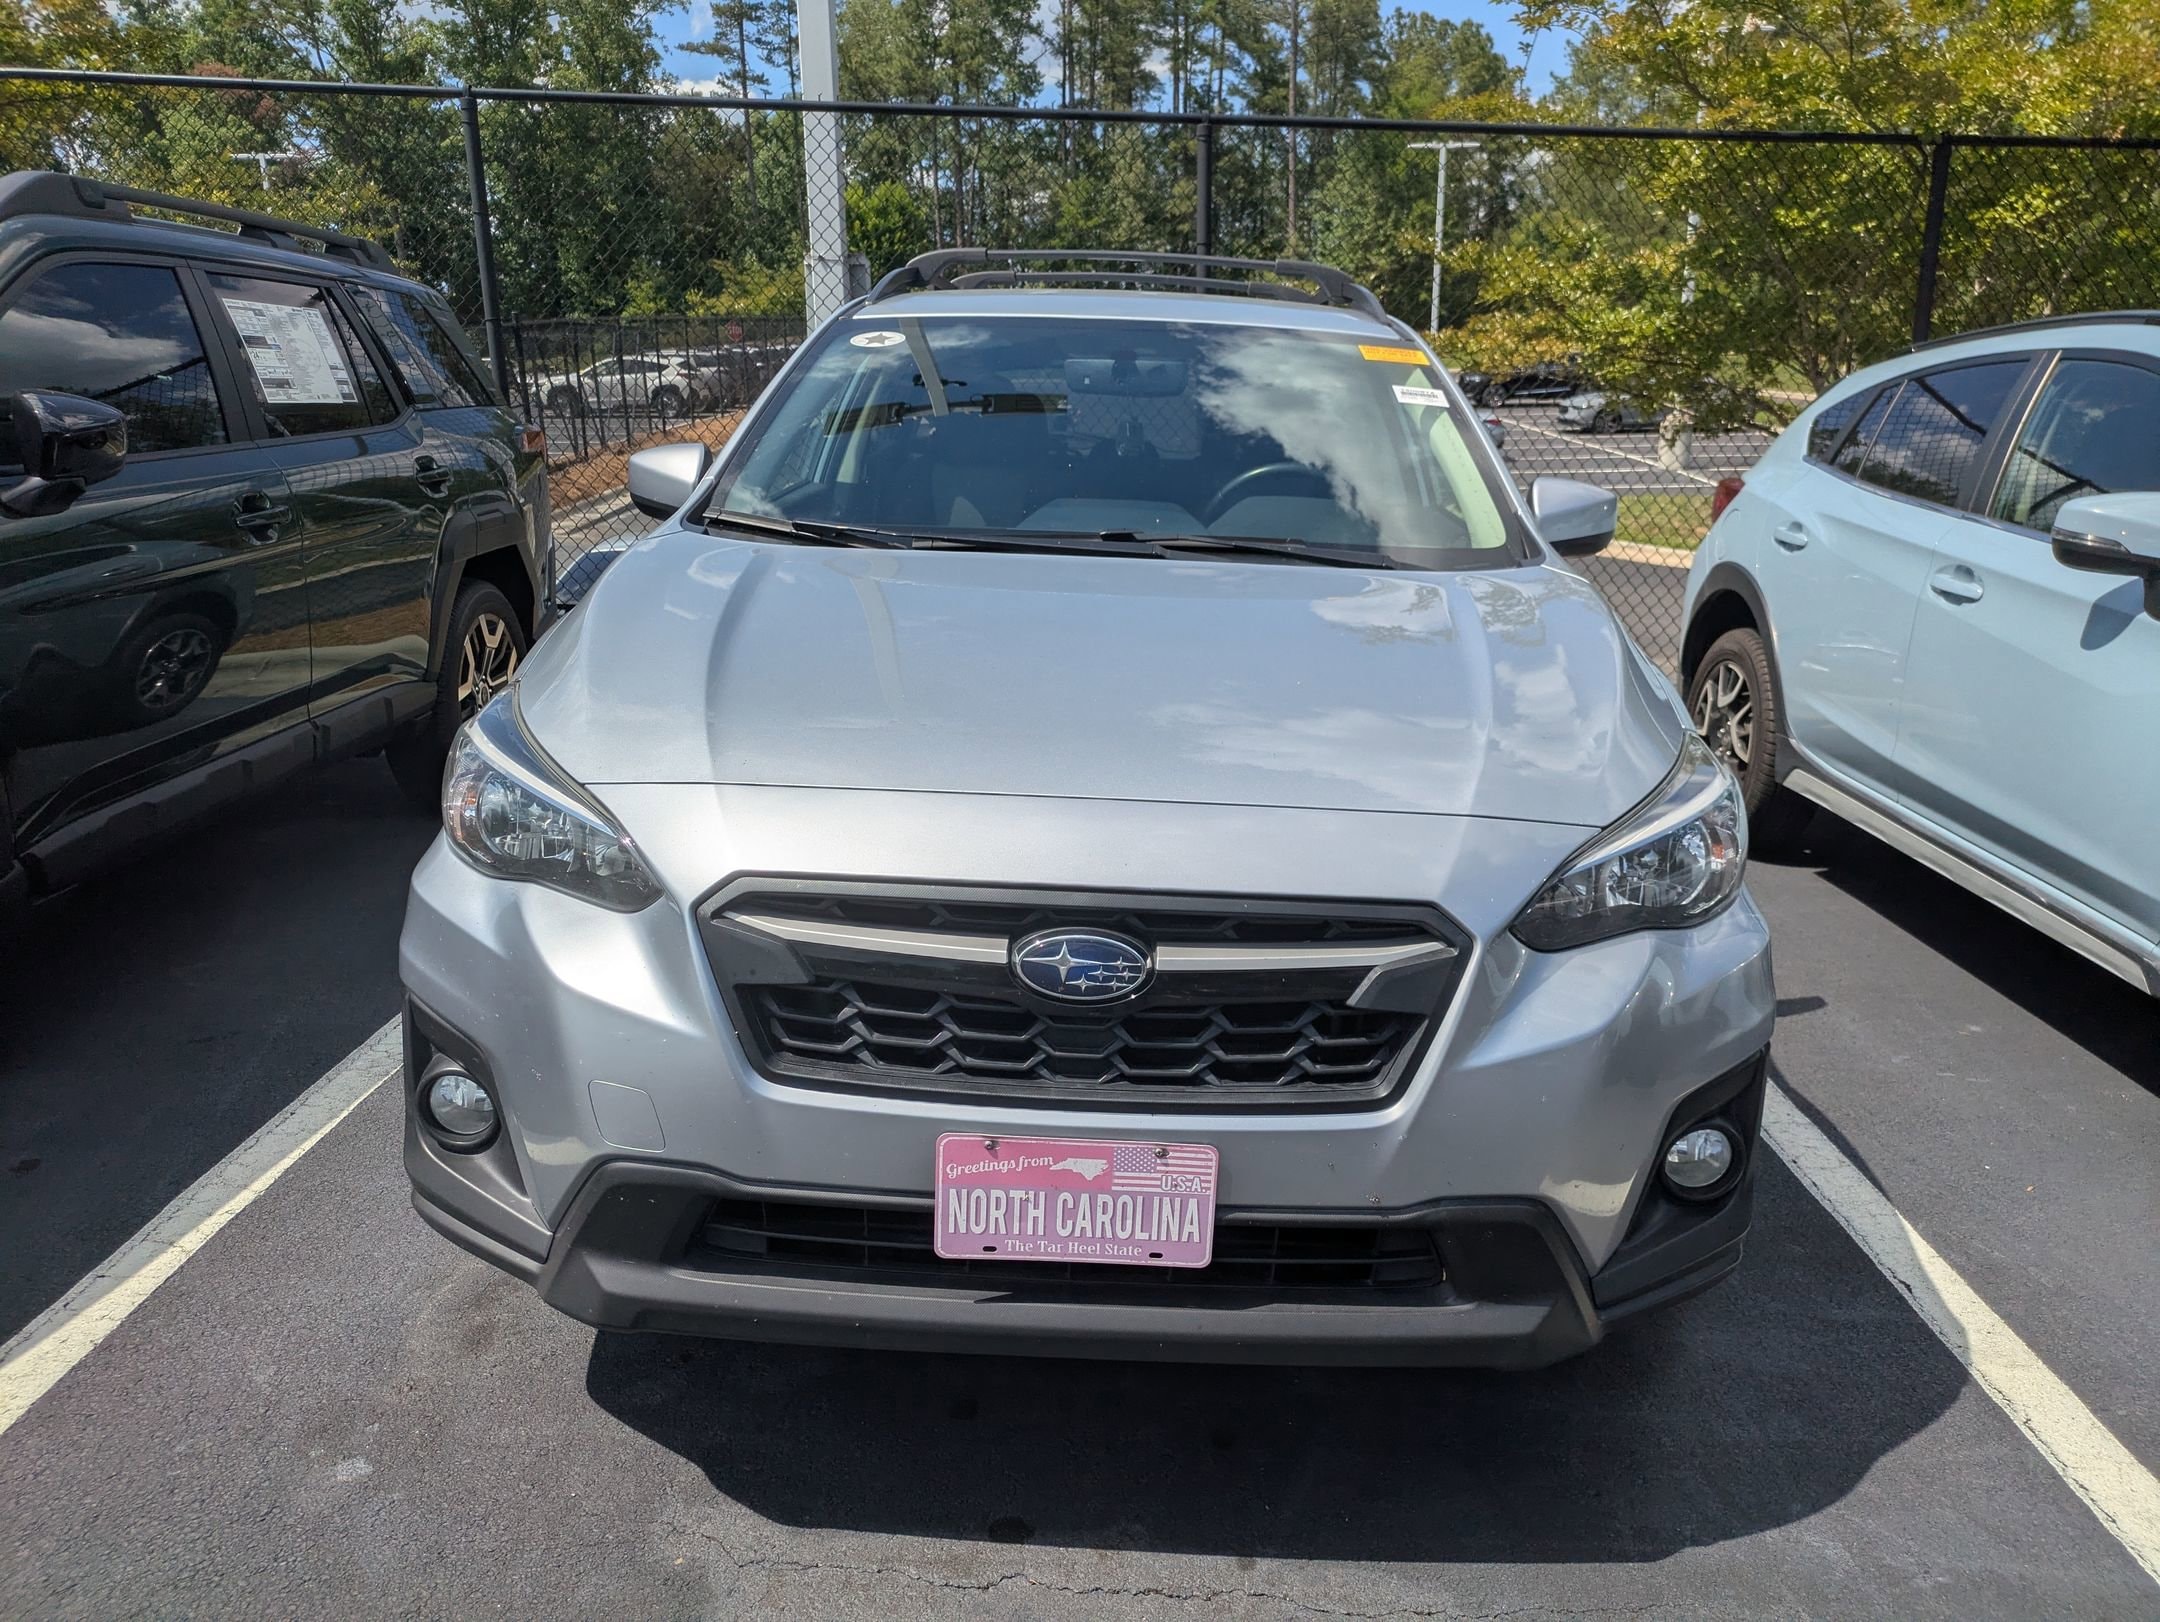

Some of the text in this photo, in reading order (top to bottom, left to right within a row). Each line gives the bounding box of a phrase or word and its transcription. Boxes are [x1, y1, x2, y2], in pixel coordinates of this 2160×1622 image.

[946, 1155, 1054, 1179] Greetings from
[1160, 1174, 1208, 1193] U.S.A.
[948, 1188, 1201, 1243] NORTH CAROLINA
[1004, 1239, 1142, 1256] The Tar Heel State
